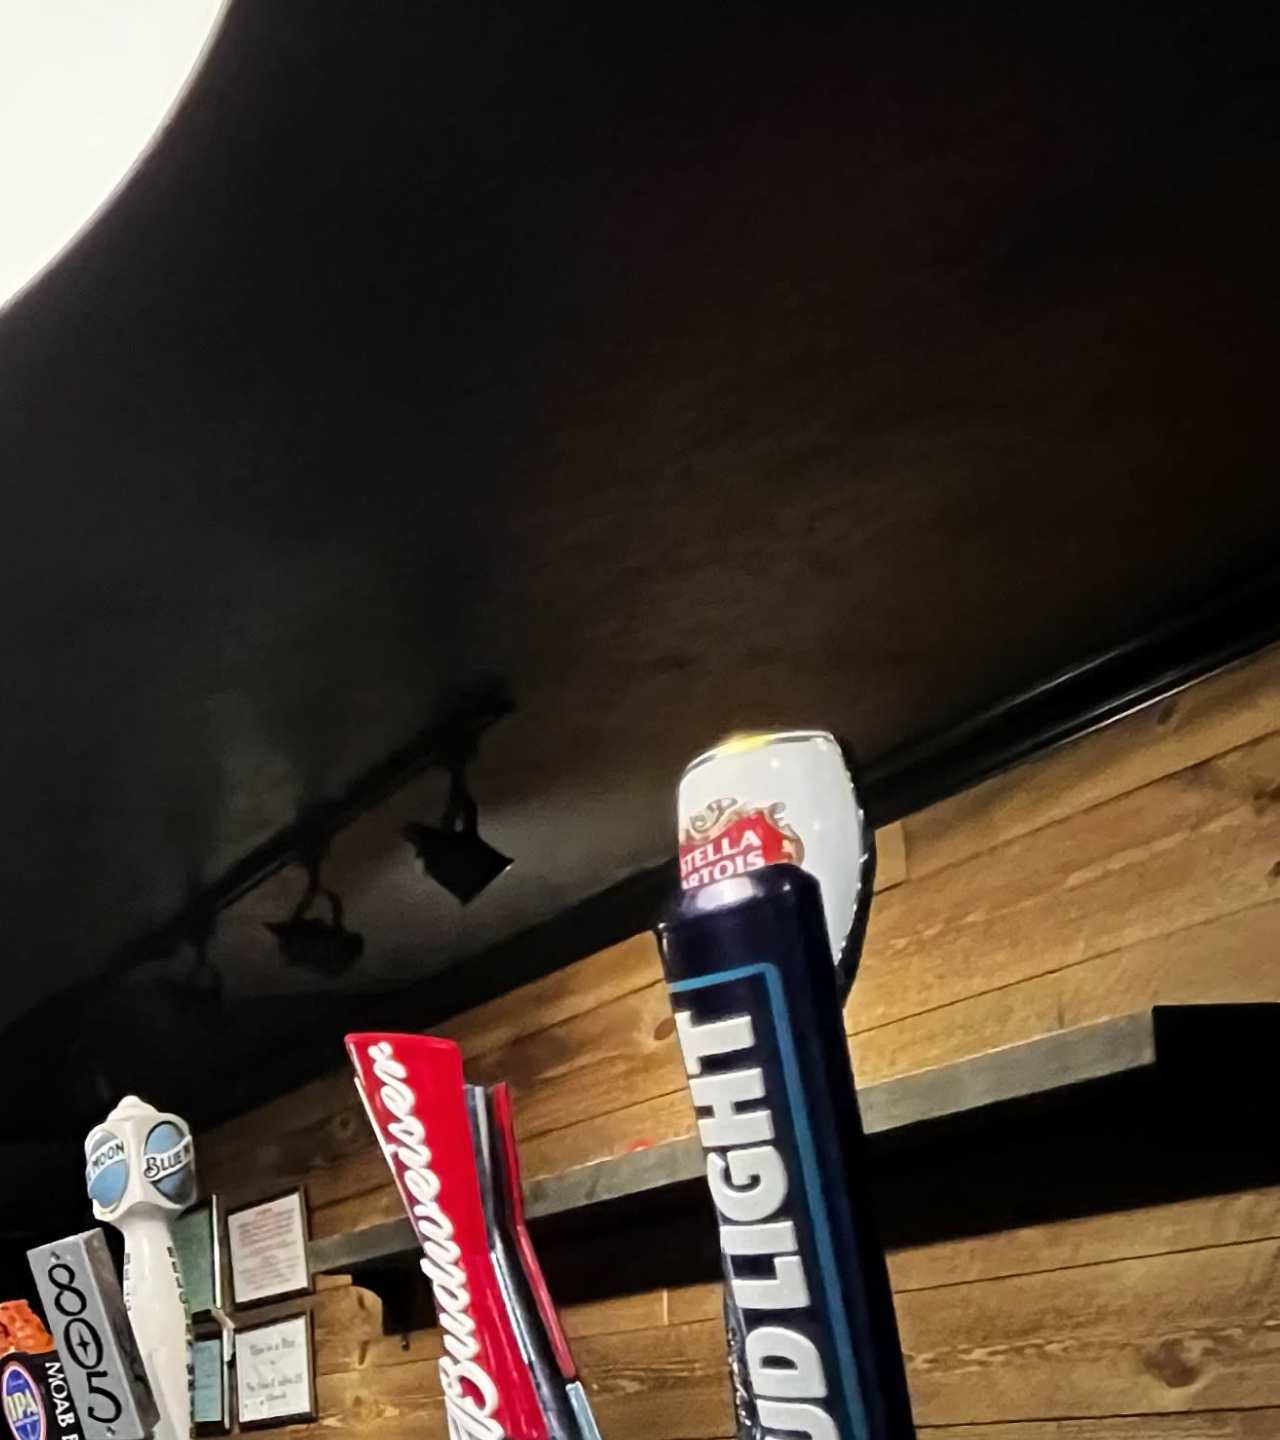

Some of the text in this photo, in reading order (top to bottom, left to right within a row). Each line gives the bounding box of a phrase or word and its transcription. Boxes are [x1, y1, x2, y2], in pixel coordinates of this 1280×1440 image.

[675, 1010, 811, 1310] LIGHT
[6, 1388, 40, 1422] IPA
[45, 1361, 76, 1428] MOAB
